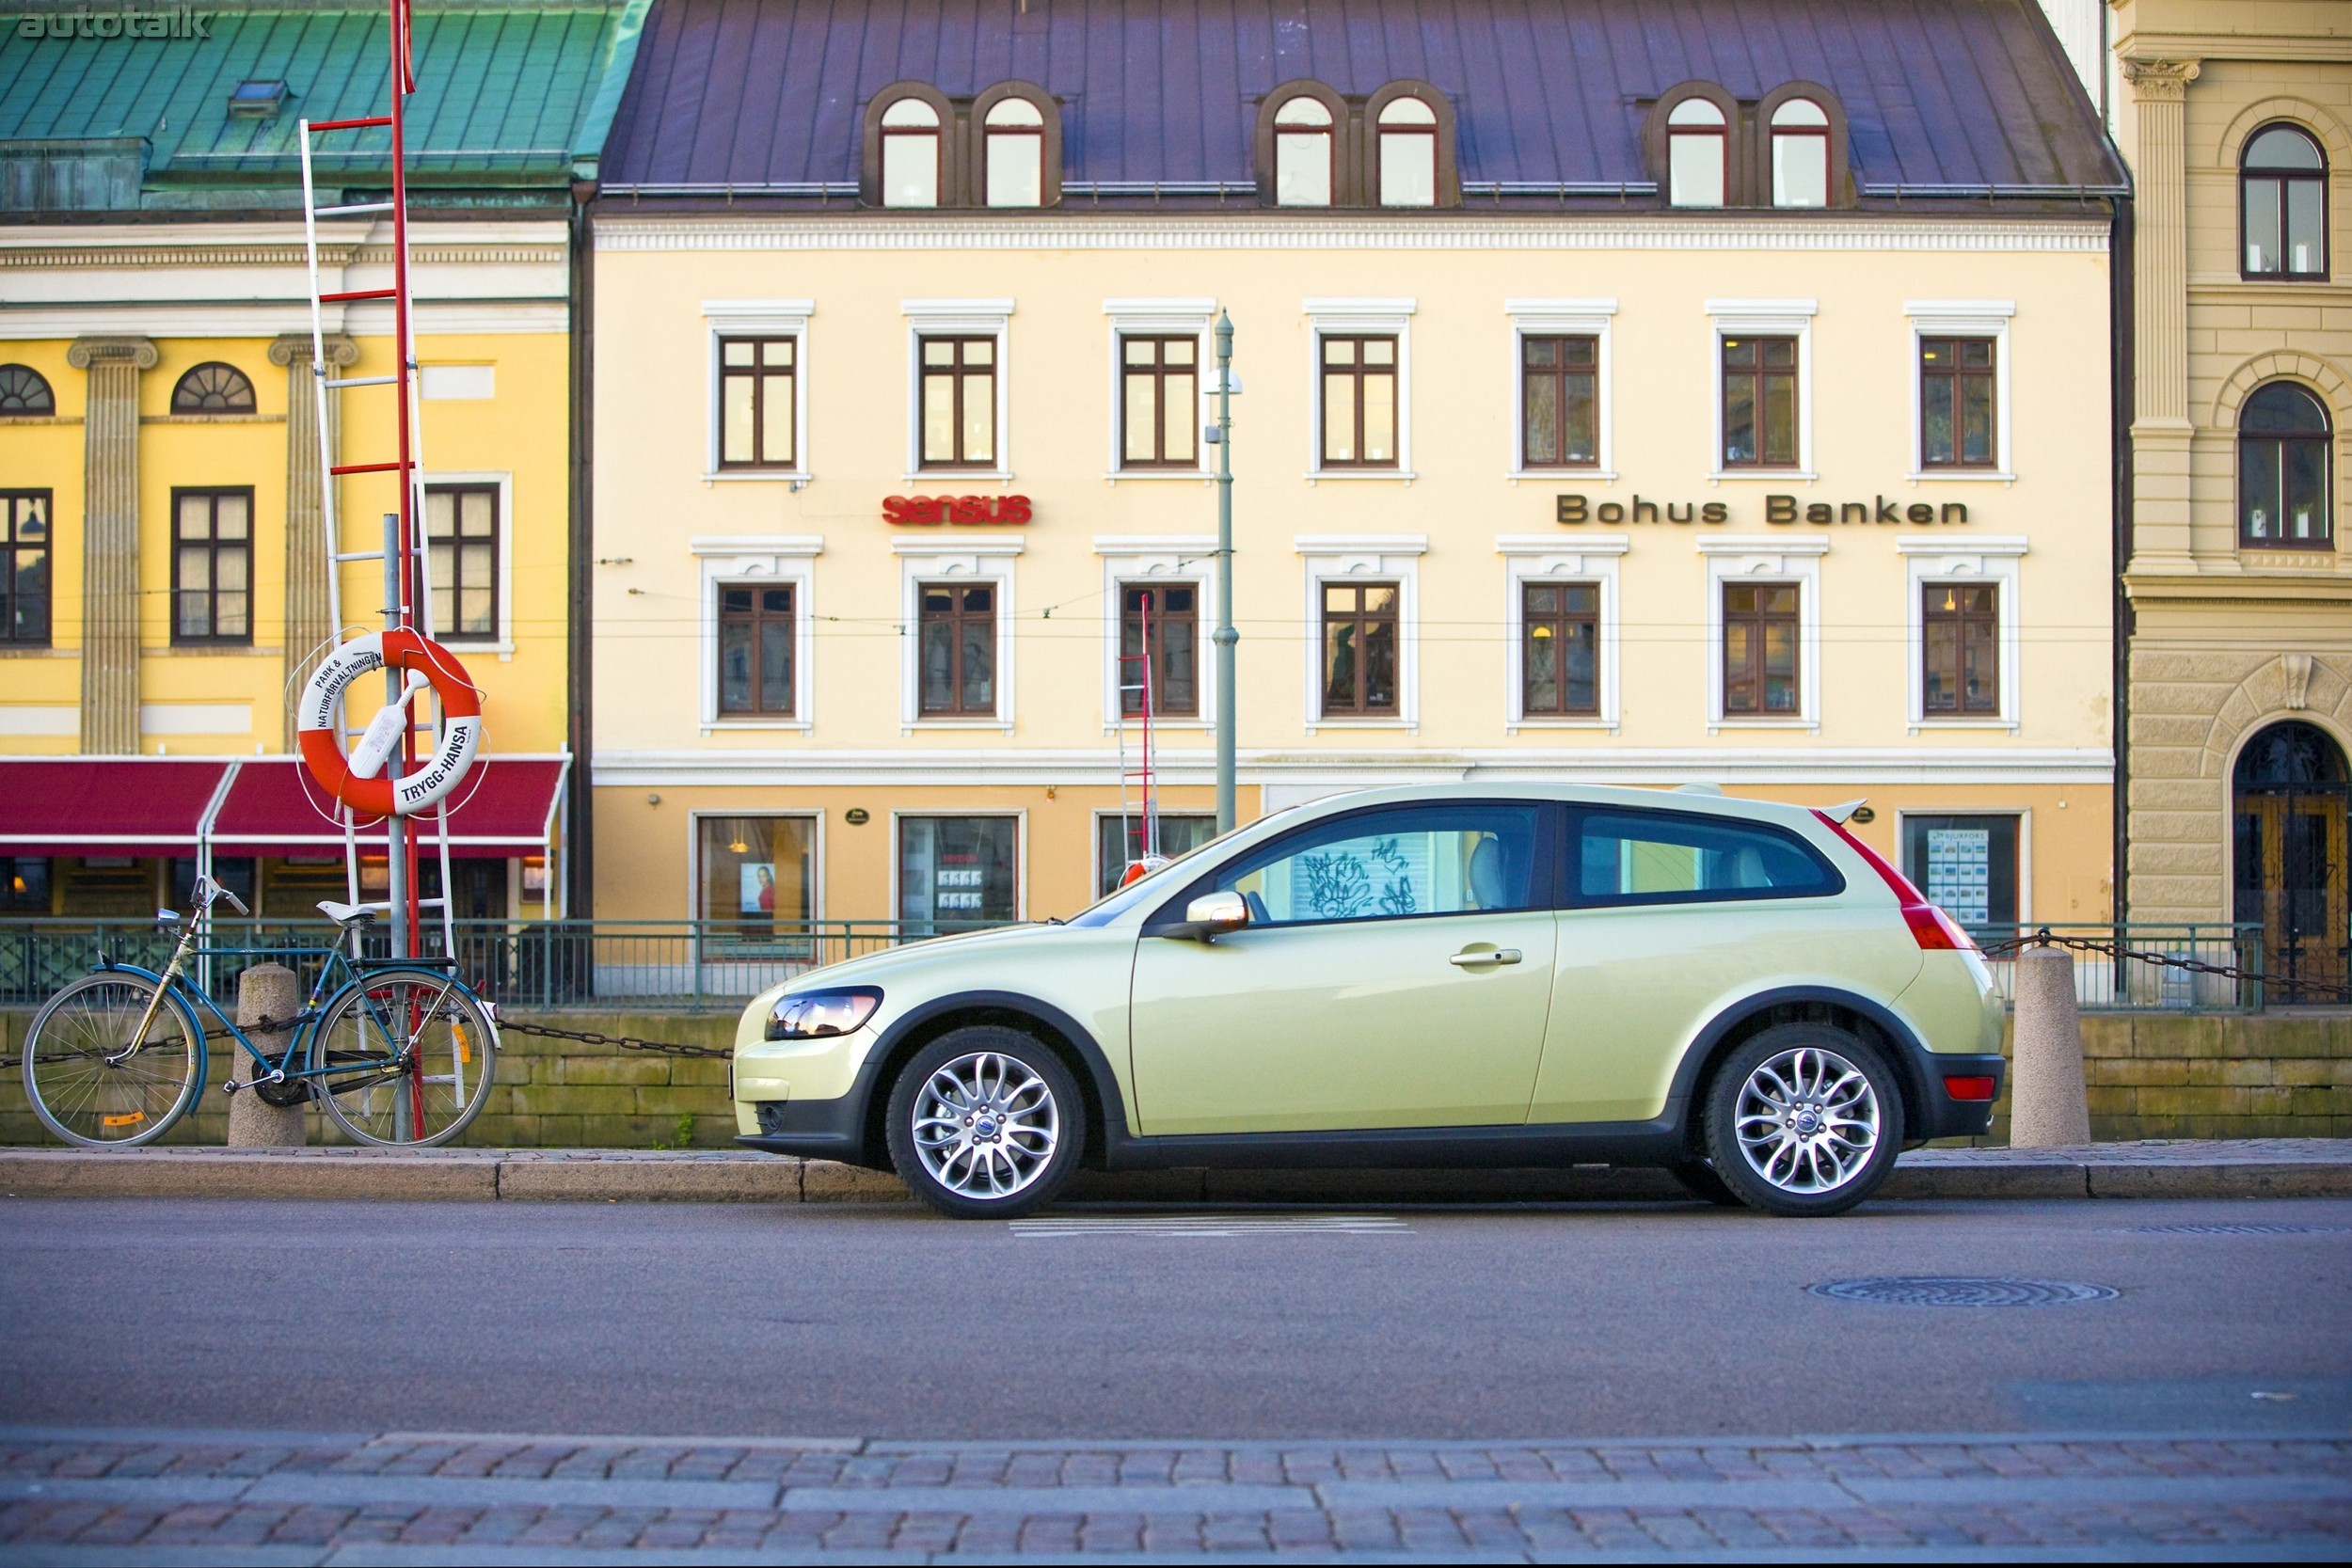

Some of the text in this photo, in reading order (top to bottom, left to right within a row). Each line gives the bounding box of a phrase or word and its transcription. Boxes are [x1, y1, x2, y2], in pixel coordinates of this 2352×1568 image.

[882, 494, 1033, 526] sensus
[1556, 494, 1968, 524] Bohus Banken
[314, 659, 342, 689] PARK &
[401, 725, 469, 801] TRYGG-HANSA
